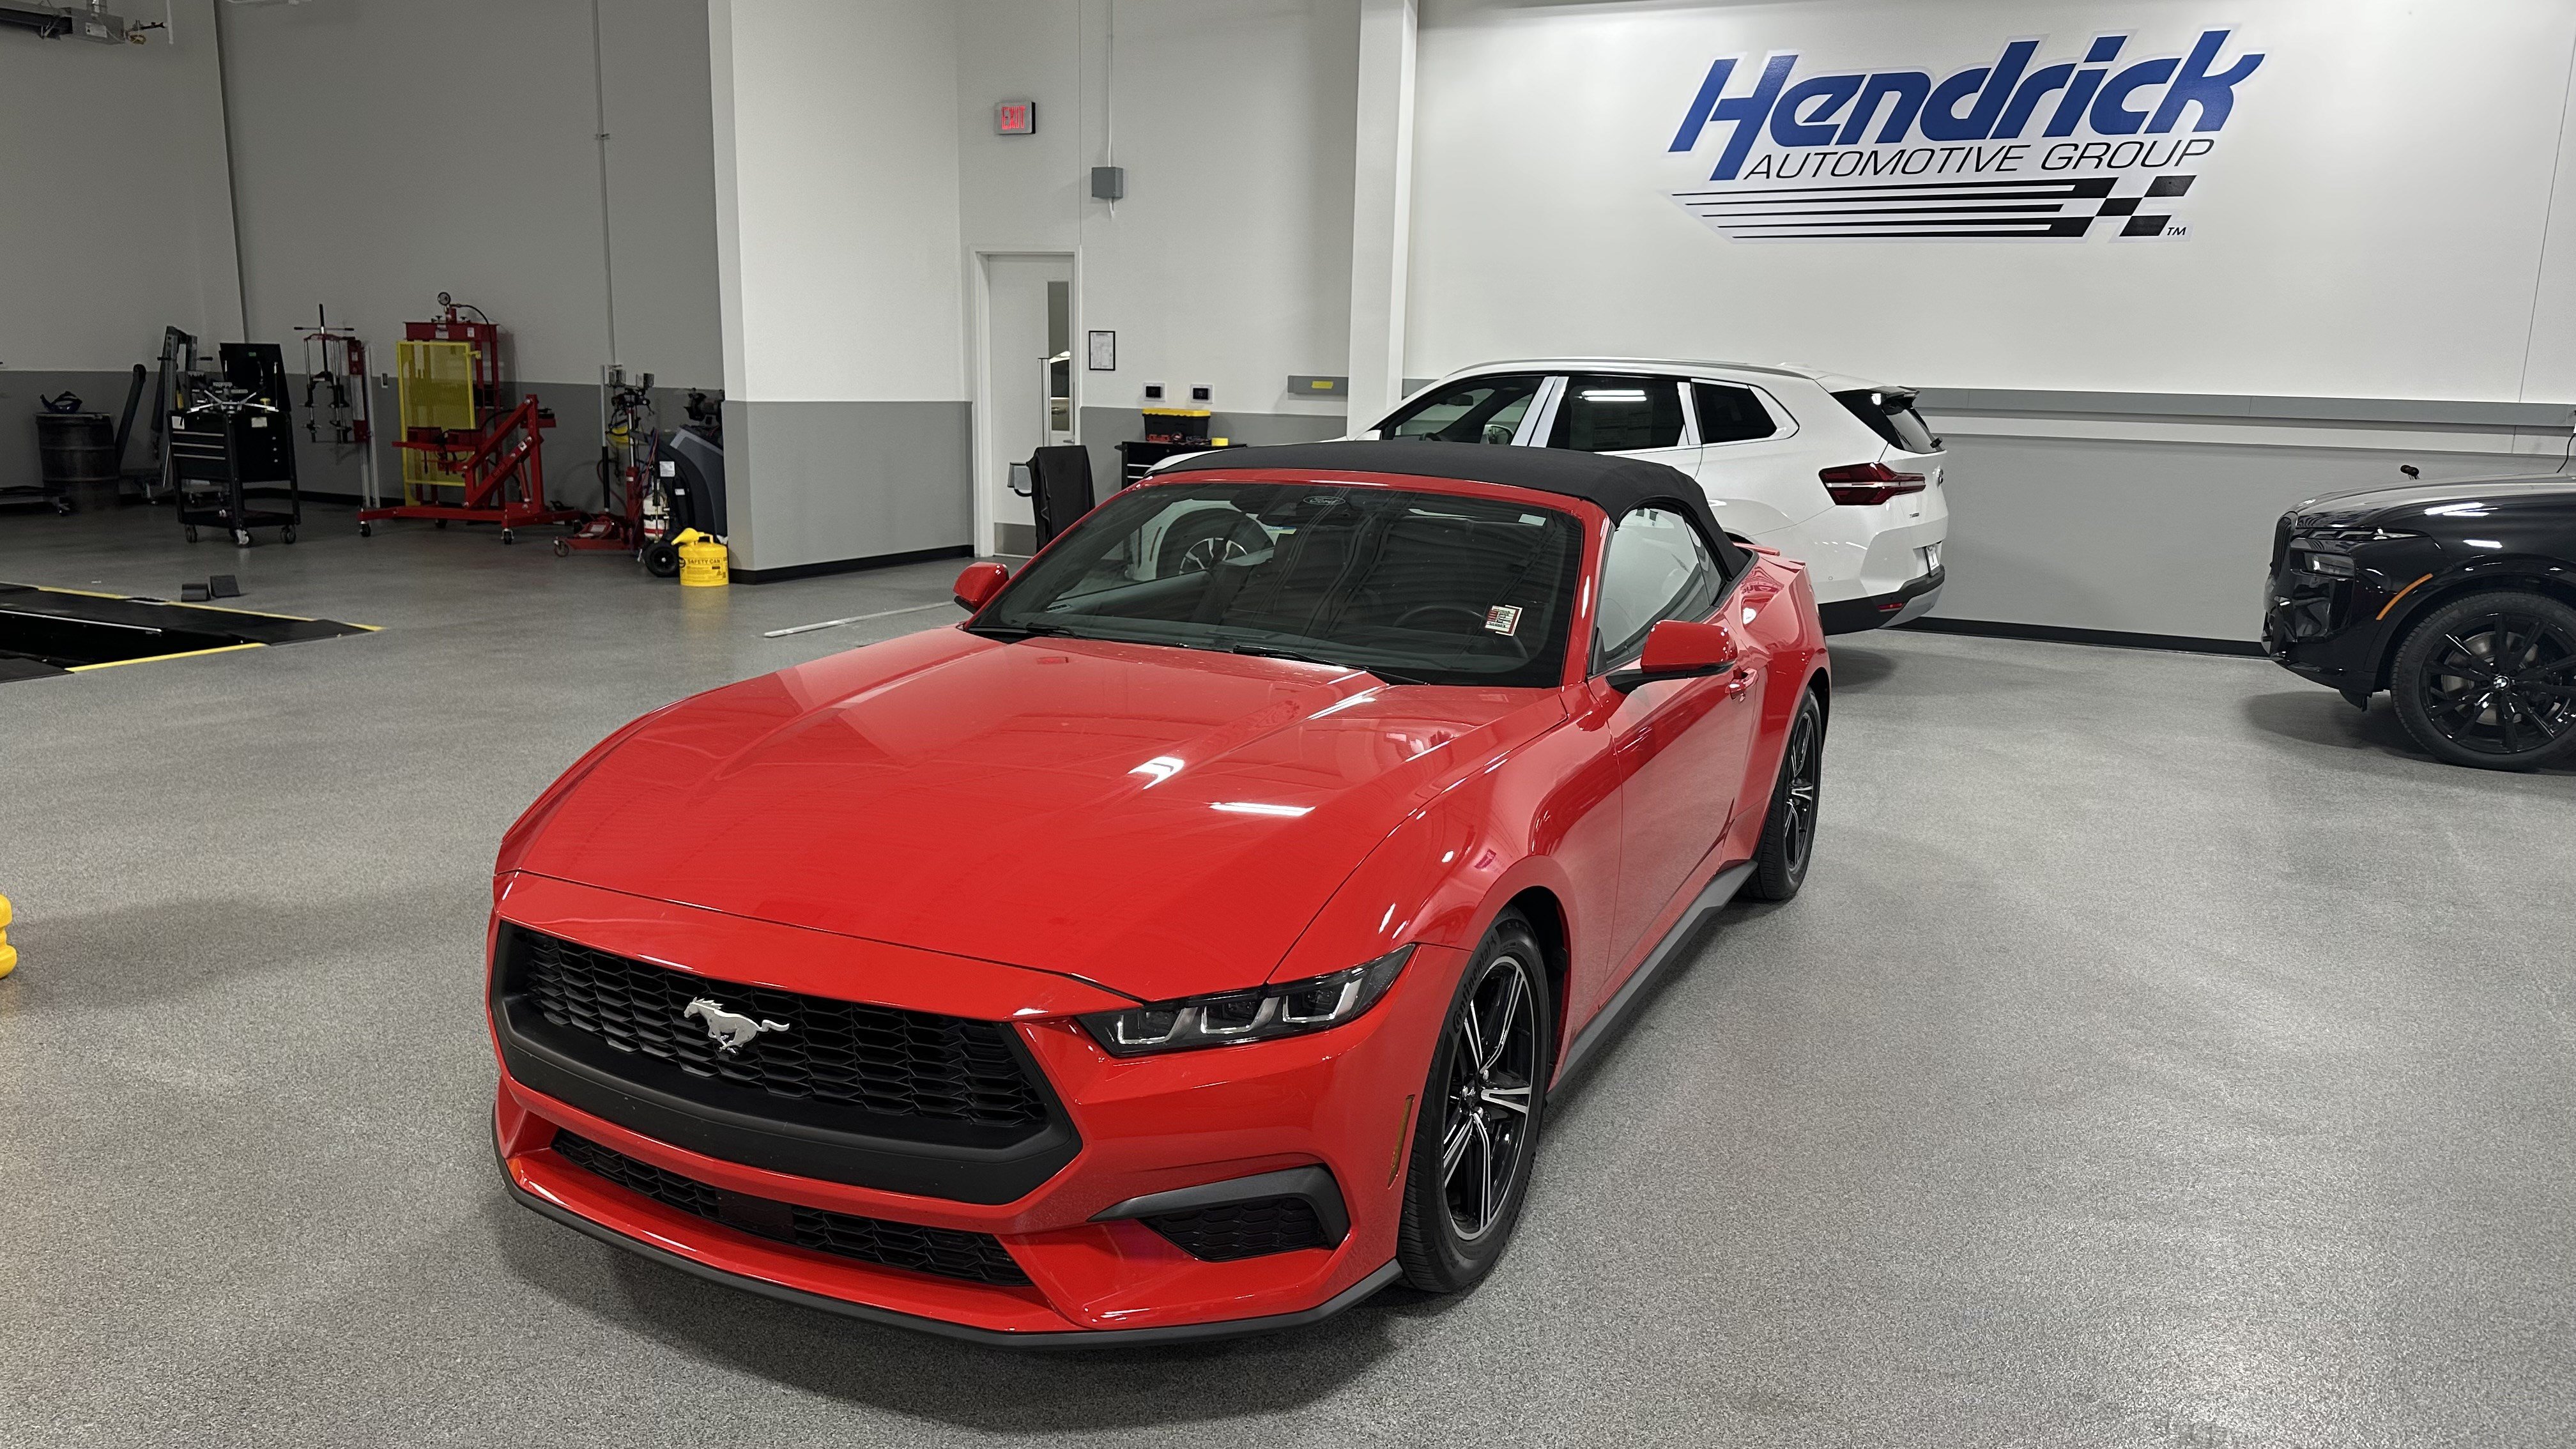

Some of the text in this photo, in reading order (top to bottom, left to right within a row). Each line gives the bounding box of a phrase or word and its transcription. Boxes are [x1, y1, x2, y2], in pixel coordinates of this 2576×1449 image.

[1001, 105, 1025, 130] EXIT
[1667, 29, 2266, 181] Hendrick
[1743, 139, 2215, 180] AUTOMOTIVE GROUP
[2167, 227, 2187, 236] TM
[1453, 945, 1492, 1034] Continental
